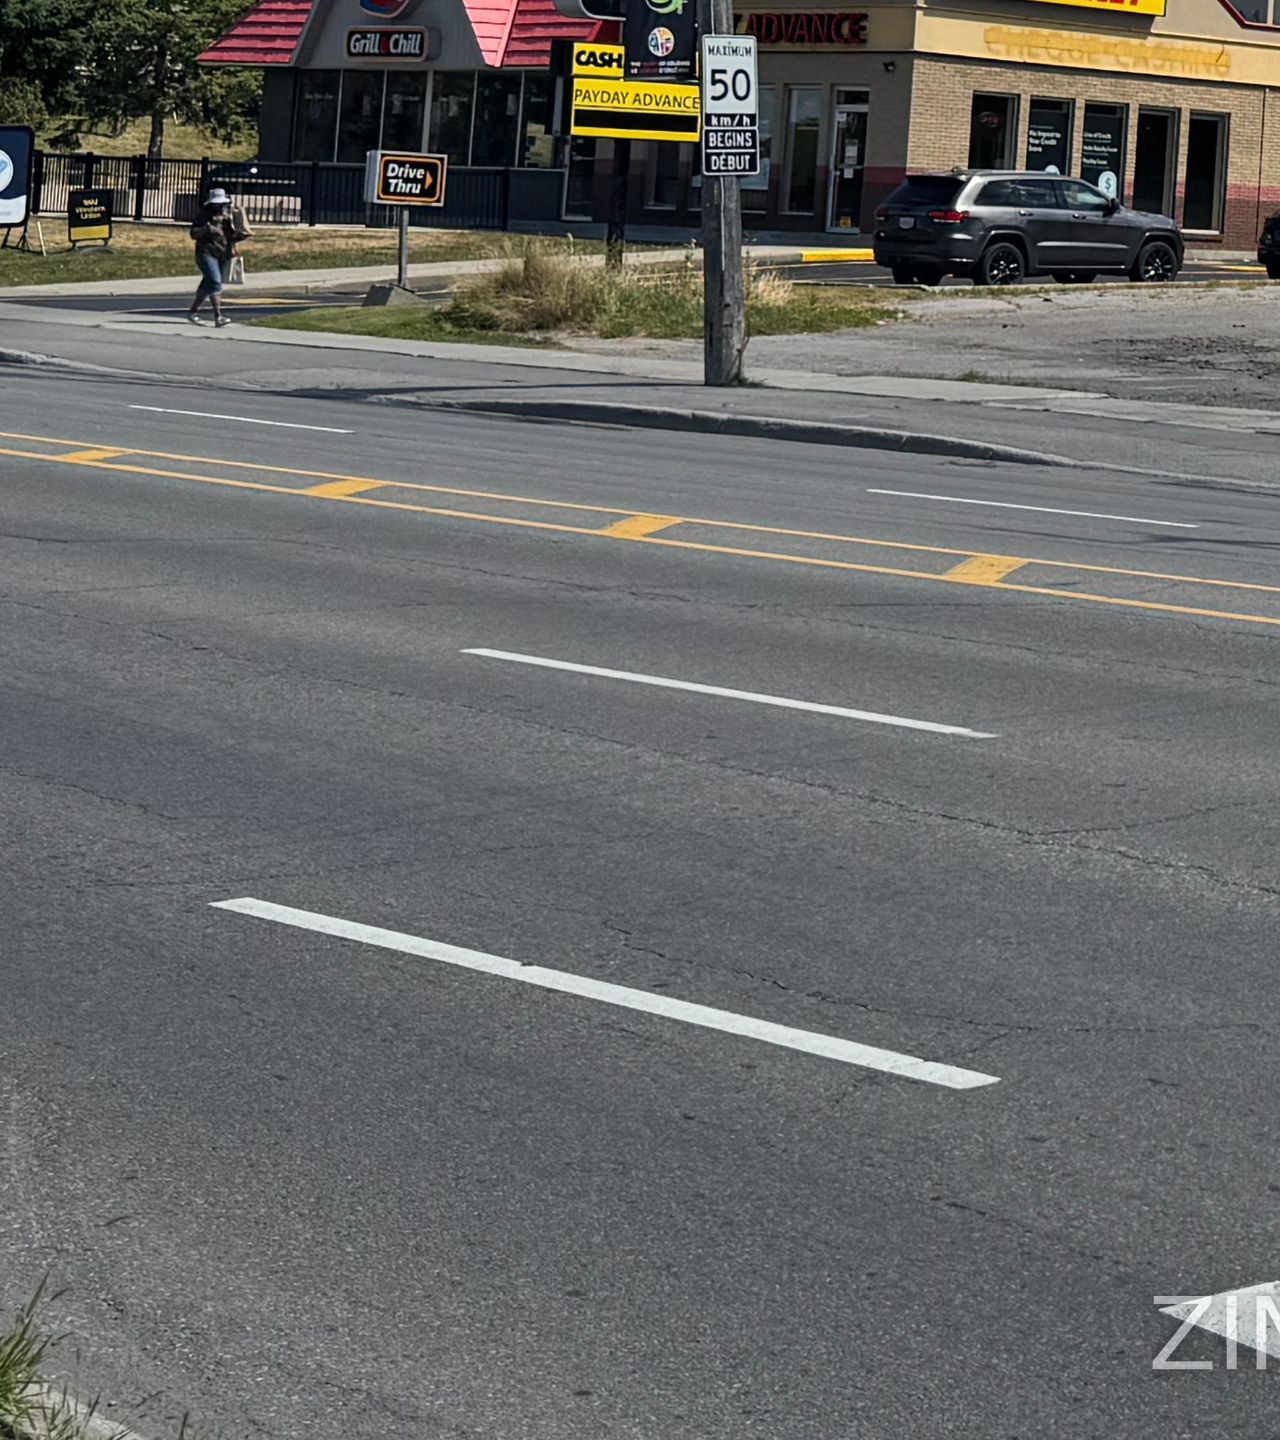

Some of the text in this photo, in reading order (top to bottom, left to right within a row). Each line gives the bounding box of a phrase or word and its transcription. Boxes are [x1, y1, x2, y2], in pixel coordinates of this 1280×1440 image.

[745, 13, 868, 44] ADVANCE
[350, 33, 380, 54] Grill
[389, 33, 421, 54] Chill
[708, 44, 752, 57] MAXIMUM
[711, 69, 750, 101] 50
[575, 88, 701, 110] PAYDAY ADVANCE
[709, 131, 752, 148] BEGINS
[387, 163, 425, 179] Drive
[711, 151, 750, 171] DÉBUT
[388, 178, 421, 194] Thru
